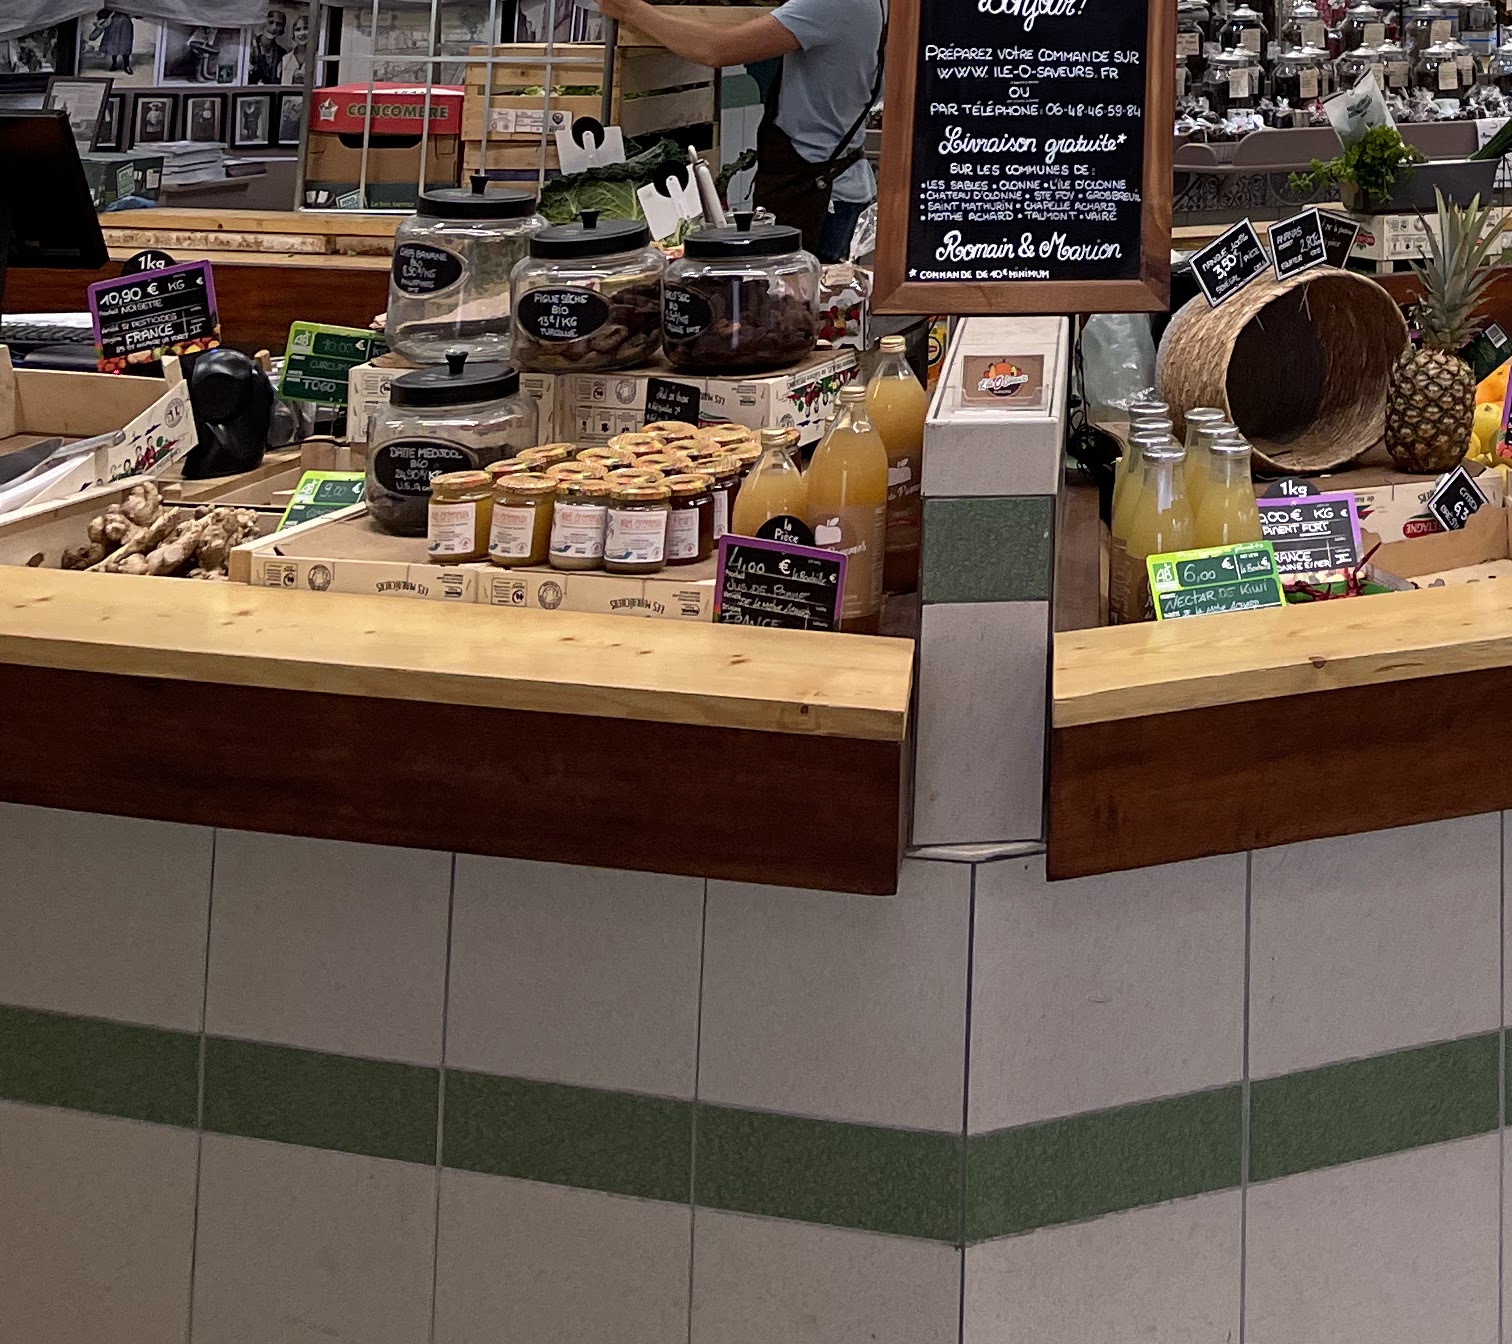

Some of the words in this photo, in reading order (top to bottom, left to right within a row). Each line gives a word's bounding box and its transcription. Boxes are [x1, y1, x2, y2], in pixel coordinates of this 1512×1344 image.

[925, 43, 993, 62] PRÉPAREZ
[1038, 48, 1110, 63] COMMANDE
[1114, 50, 1140, 64] SUR
[1009, 86, 1030, 98] OU
[930, 102, 959, 116] PAR
[938, 125, 1037, 155] Livraison
[949, 163, 973, 175] SUR
[976, 164, 1000, 175] LES
[1005, 164, 1069, 175] COMMUNES
[950, 180, 988, 191] SABLES
[999, 180, 1041, 190] OLONNE
[961, 199, 1013, 211] MATHURIN
[1024, 201, 1071, 211] CHAPELLE
[928, 211, 963, 221] MOTHE
[968, 212, 1013, 221] ACHARD
[936, 230, 1015, 261] Romain
[1018, 232, 1035, 259] &
[1039, 231, 1122, 261] Marion
[920, 270, 973, 279] COMMANDE
[976, 270, 988, 279] DE
[100, 287, 142, 305] 10,90
[147, 282, 159, 295] €
[168, 279, 184, 291] KG
[121, 299, 163, 314] NOISETTE
[125, 324, 174, 346] FRANCE
[303, 379, 337, 393] TOGO
[390, 447, 415, 458] DATTE
[1280, 482, 1308, 498] 1kg
[1290, 509, 1303, 522] €
[1313, 509, 1334, 519] KG
[1301, 521, 1331, 534] FORT
[774, 528, 799, 544] Pièce
[728, 546, 765, 573] 4,00
[779, 559, 791, 574] €
[1183, 564, 1216, 583] 6,00
[1222, 557, 1234, 570] €
[1165, 590, 1214, 611] NECTAR
[1218, 586, 1234, 598] DE
[1240, 581, 1268, 596] KIWI
